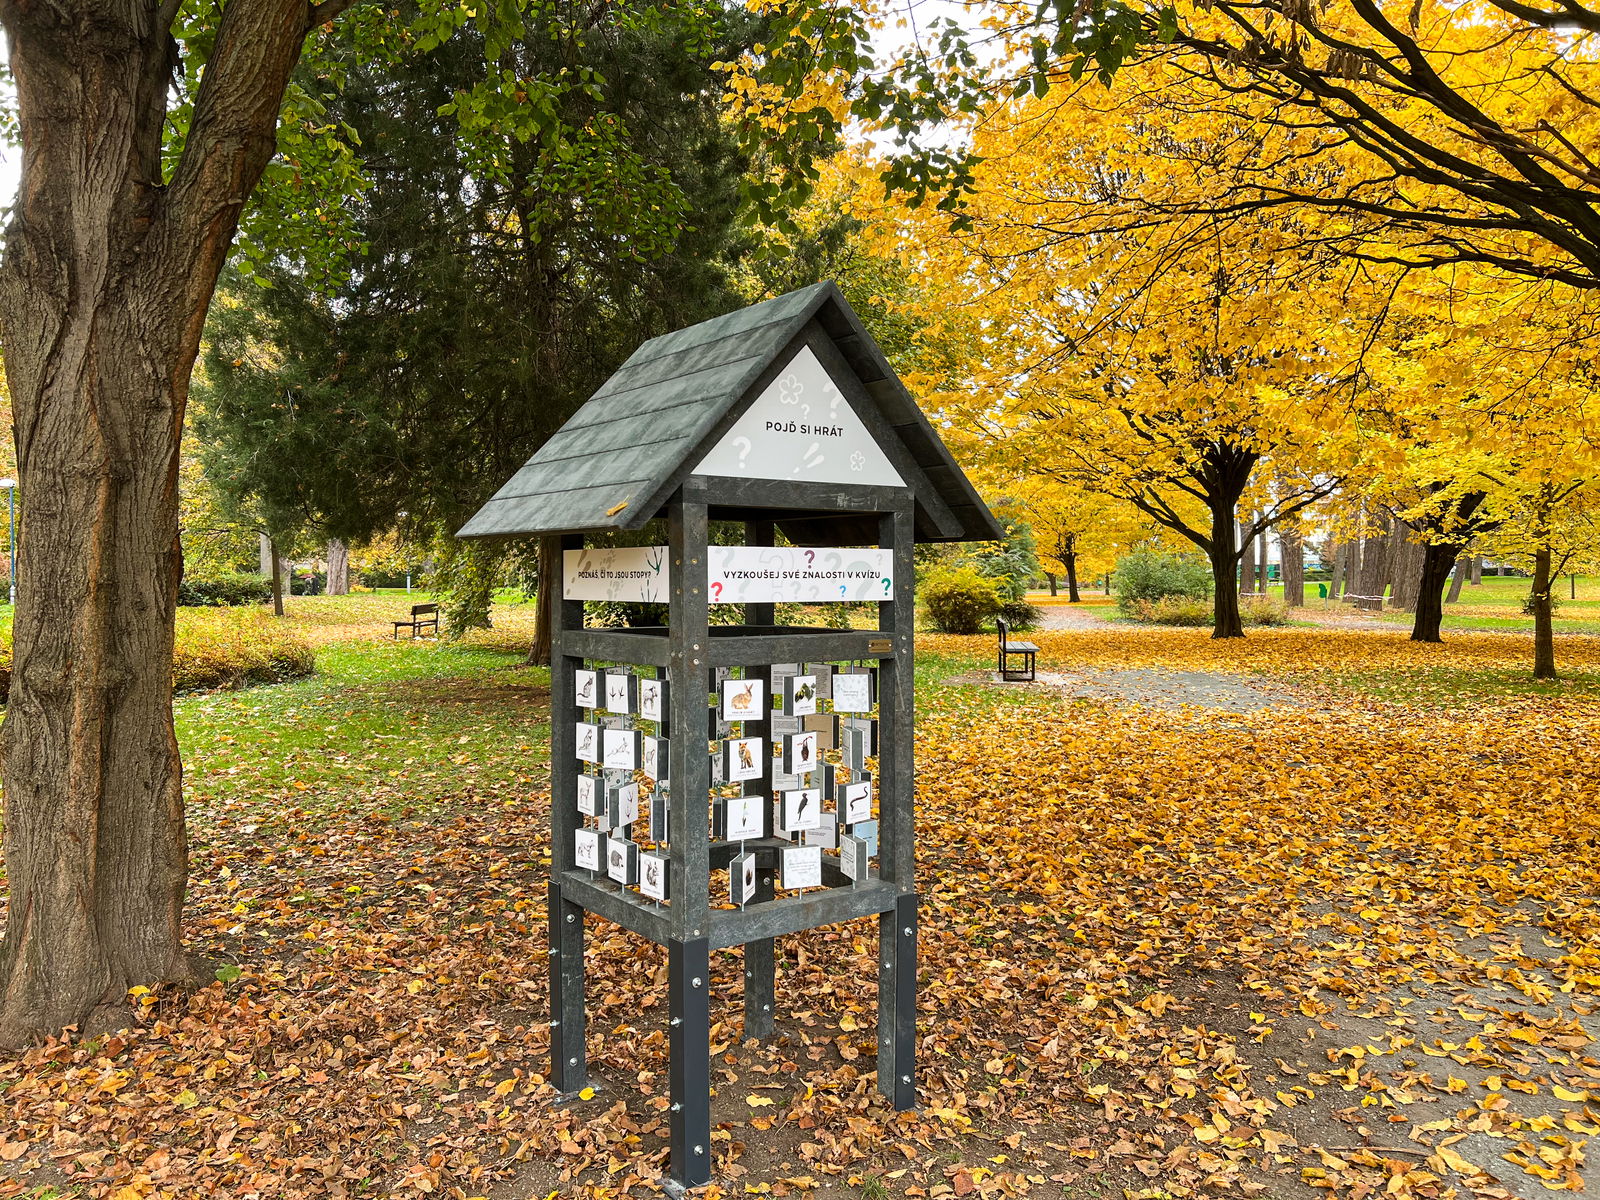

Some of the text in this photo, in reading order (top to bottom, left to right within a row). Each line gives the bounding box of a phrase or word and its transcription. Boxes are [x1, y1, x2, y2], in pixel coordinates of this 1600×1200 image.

[766, 420, 843, 437] POJĎ SI HRÁT
[578, 570, 599, 579] POZNÁŠ,
[723, 569, 880, 579] VYZKOUŠEJ SVÉ ZNALOSTI V KVÍZU
